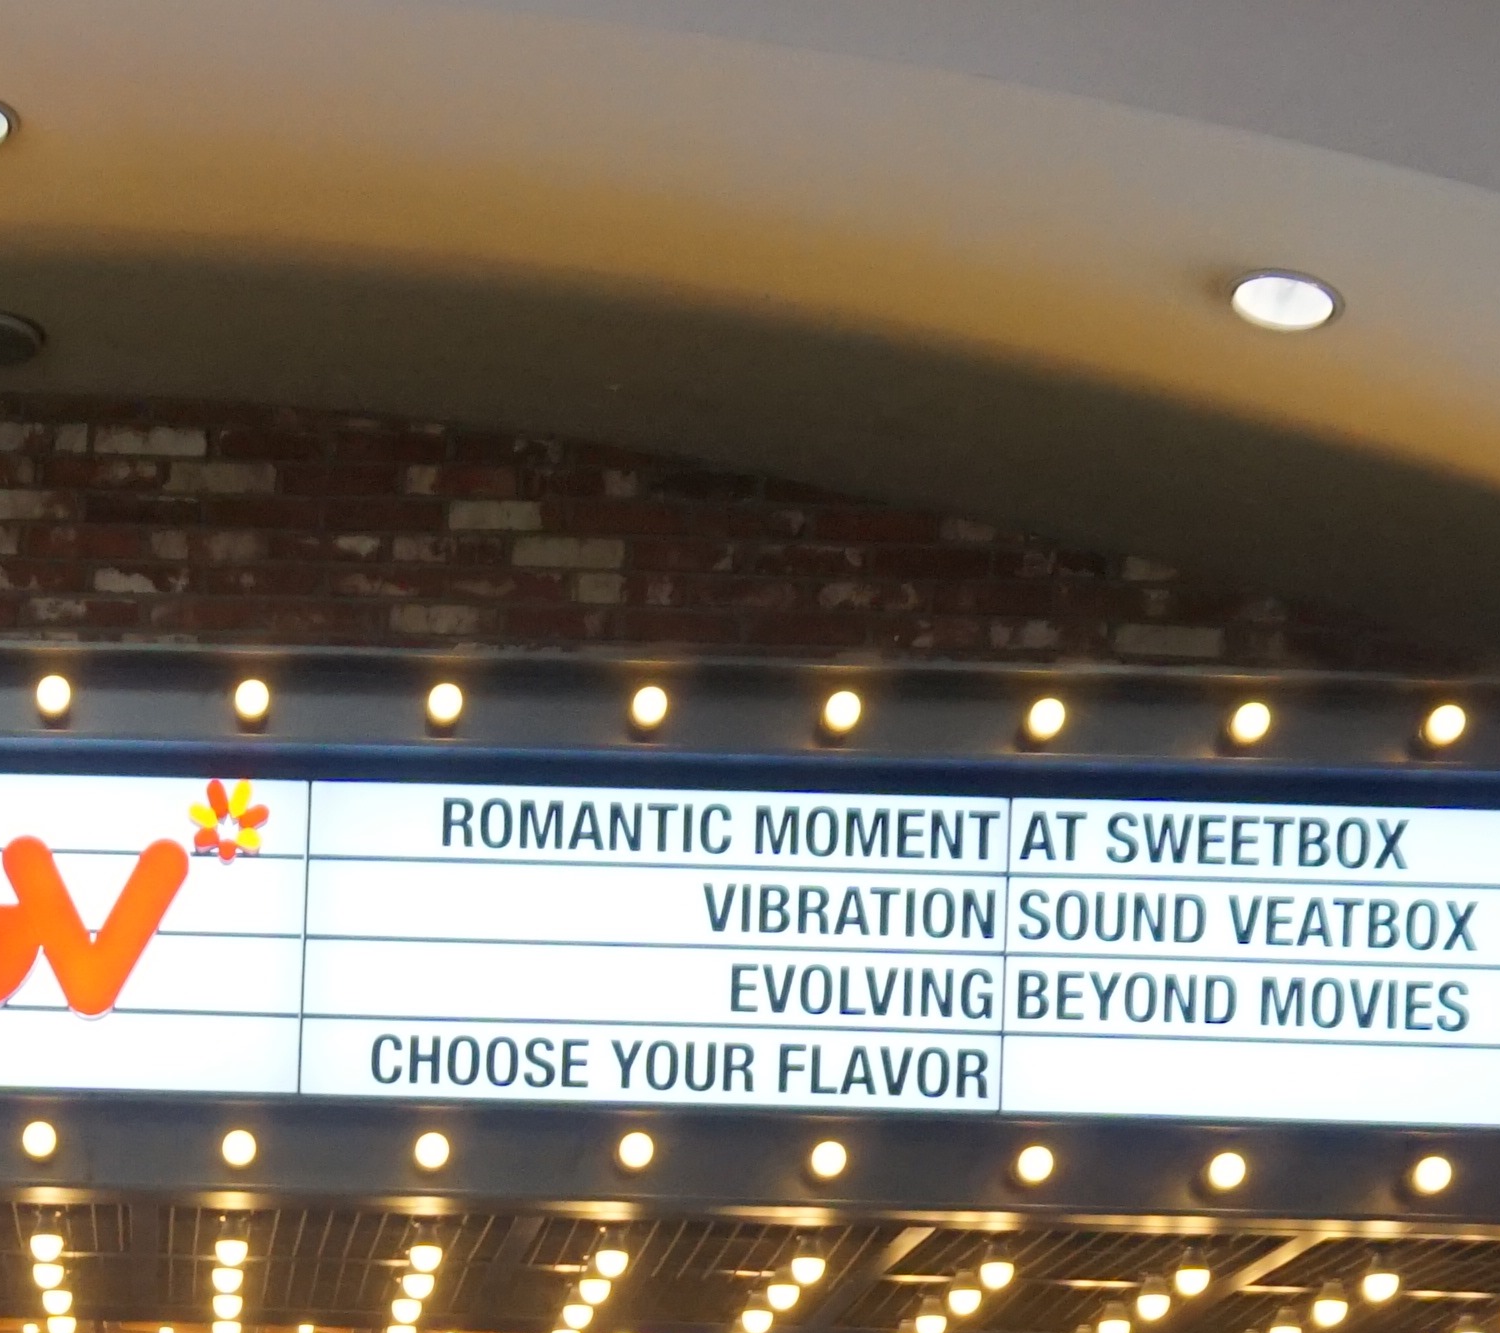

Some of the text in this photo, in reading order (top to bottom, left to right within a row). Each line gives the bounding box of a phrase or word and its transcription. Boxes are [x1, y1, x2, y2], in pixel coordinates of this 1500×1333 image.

[442, 798, 1406, 870] ROMANTIC MOMENT AT SWEETBOX
[704, 885, 1474, 951] VIBRATION SOUND VEATBOX
[730, 965, 1467, 1032] EVOLVING BEYOND MOVIES
[371, 1035, 988, 1099] CHOOSE YOUR FLAVOR
